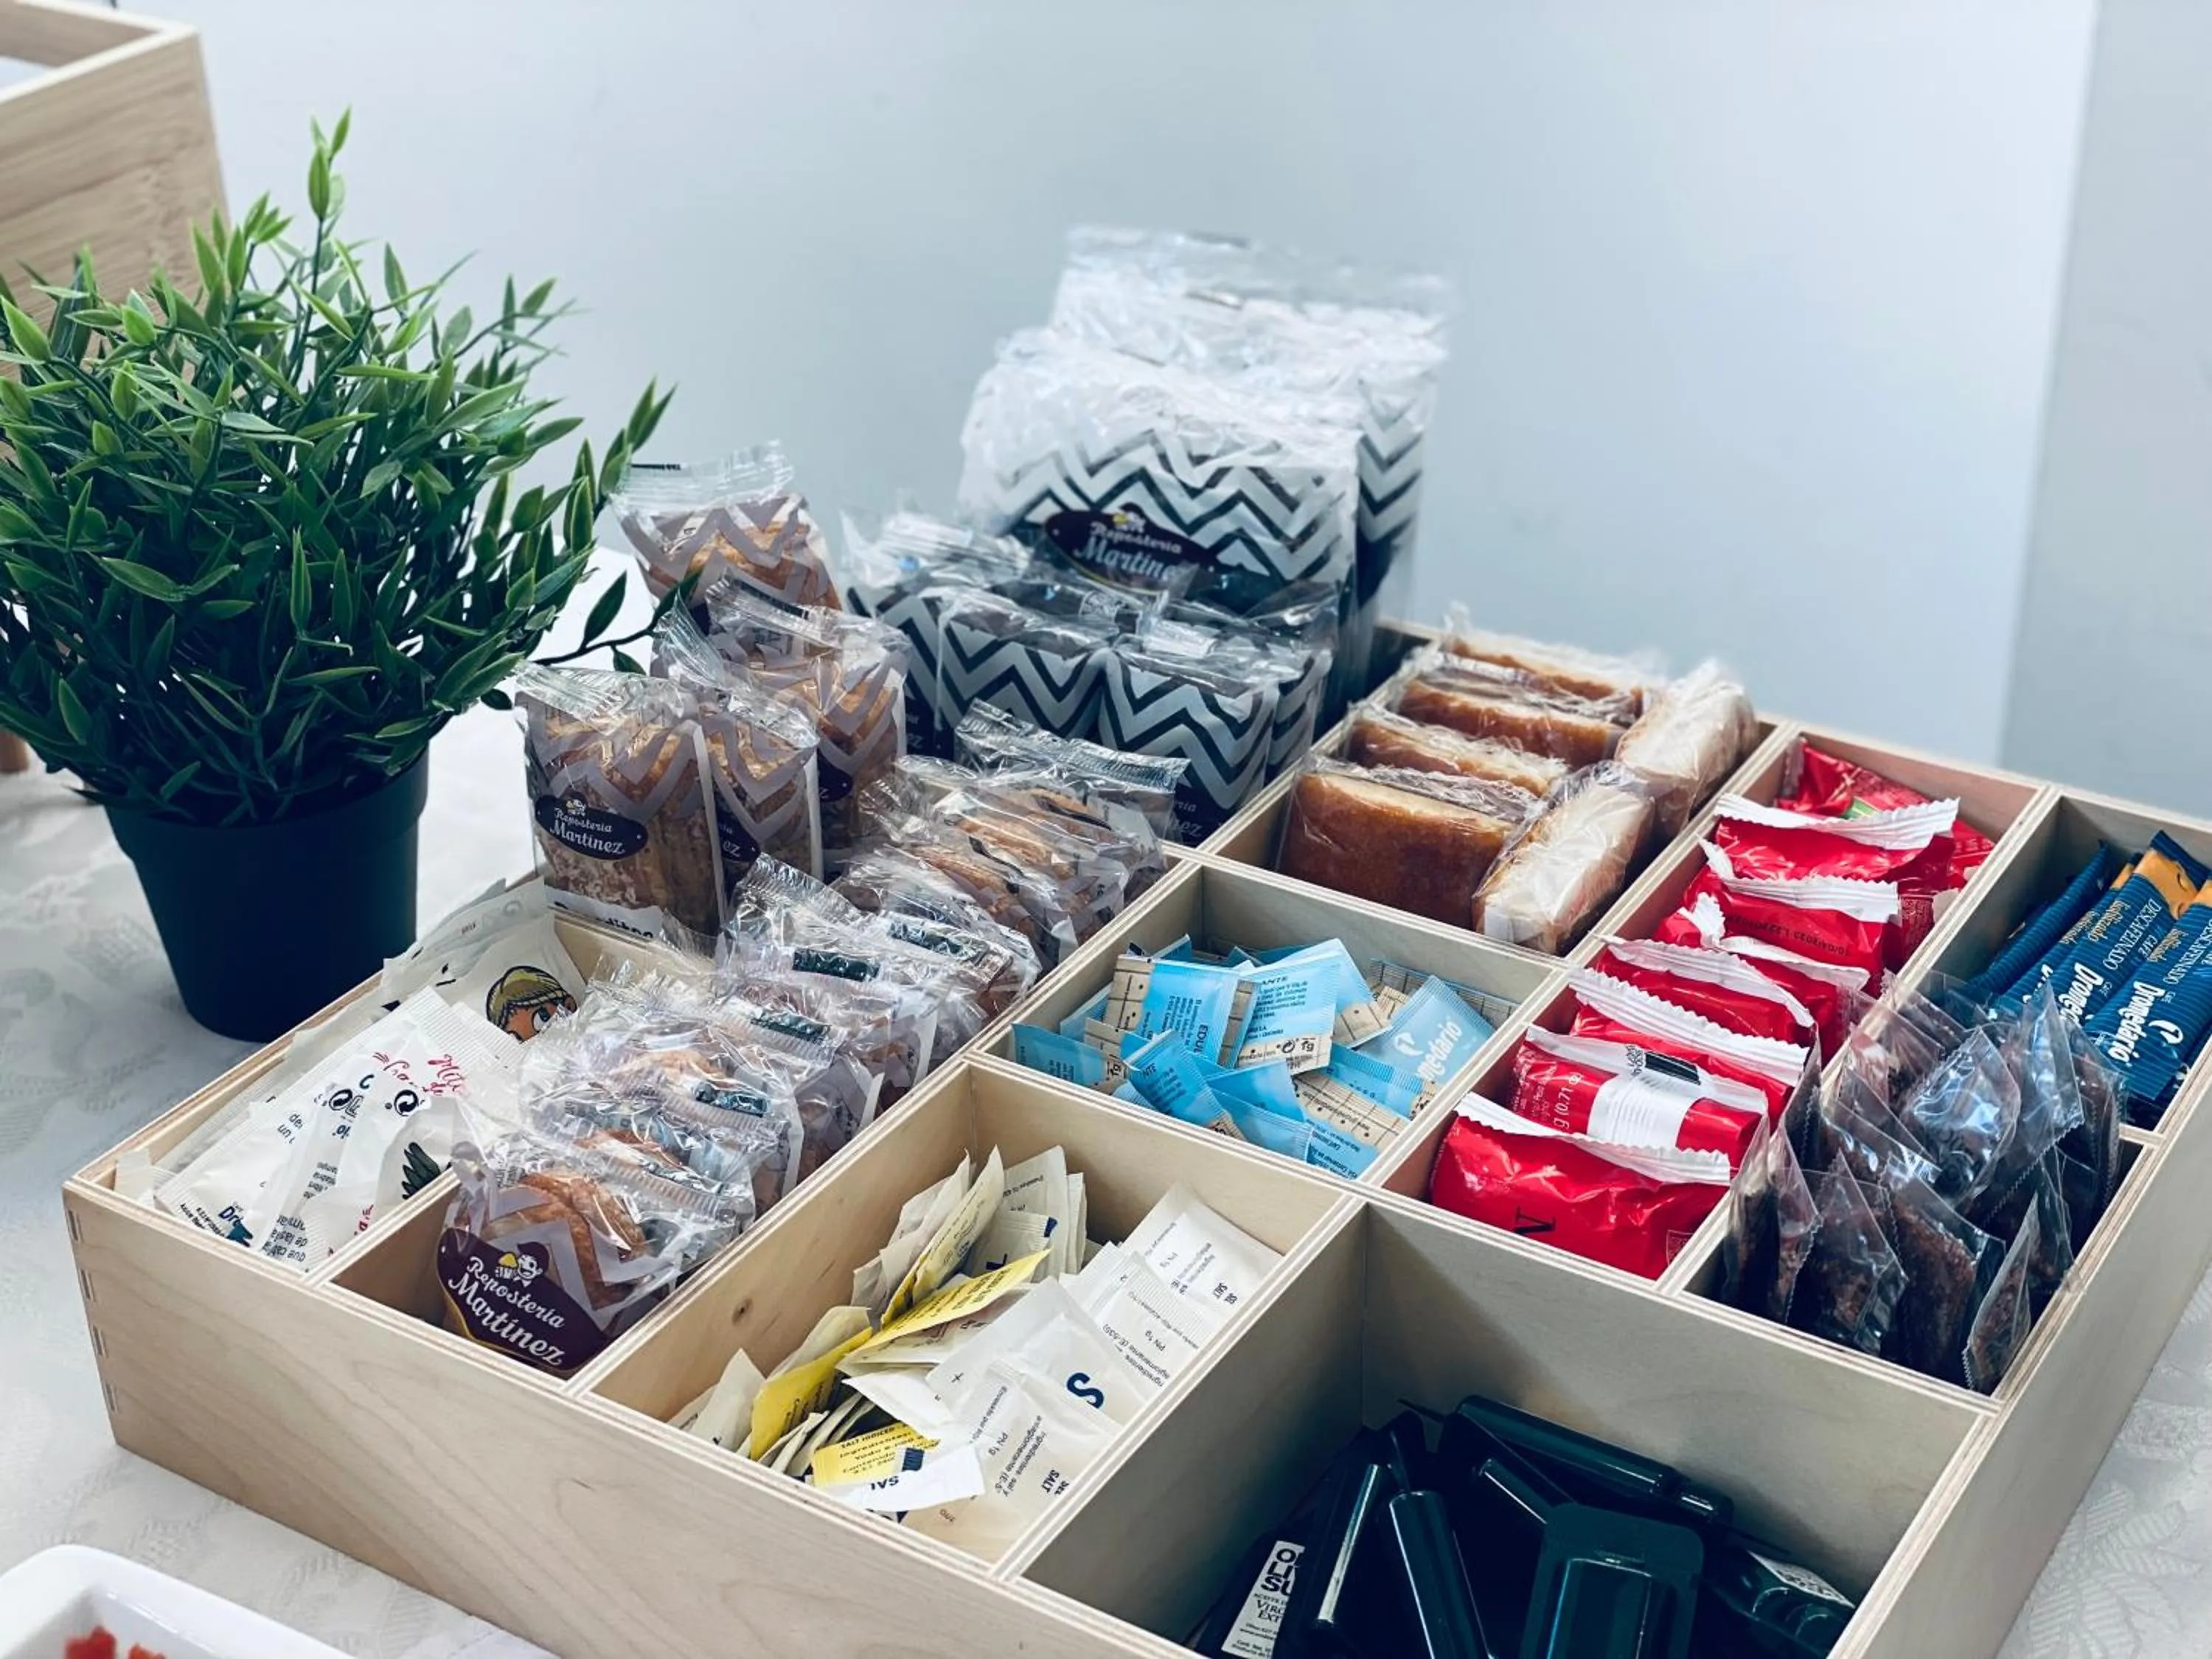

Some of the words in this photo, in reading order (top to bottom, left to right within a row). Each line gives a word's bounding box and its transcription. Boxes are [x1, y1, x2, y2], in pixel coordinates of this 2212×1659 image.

[2102, 898, 2162, 970] DESCAFEINADO
[2107, 981, 2166, 1062] Dromedario
[448, 1272, 566, 1366] Martínez
[467, 1256, 565, 1329] Repostería
